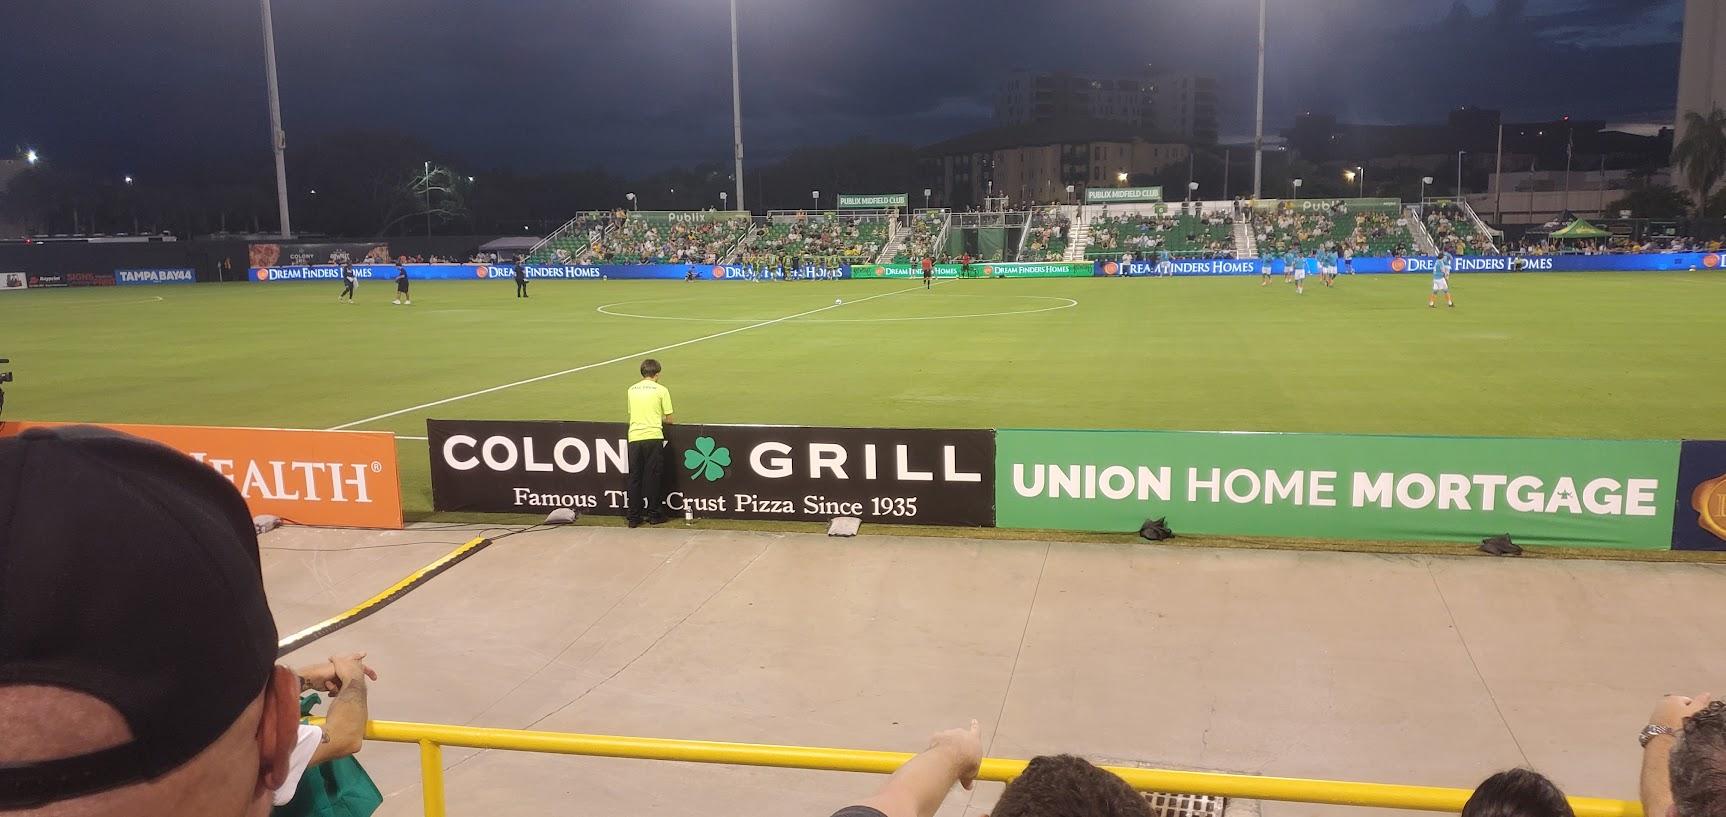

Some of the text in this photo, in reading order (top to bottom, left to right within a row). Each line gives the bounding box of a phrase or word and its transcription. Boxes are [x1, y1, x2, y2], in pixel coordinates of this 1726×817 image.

[1089, 189, 1159, 199] PUBLIX MIDFIELD CLUB
[840, 197, 861, 205] PUBLIX
[862, 196, 888, 204] MIDFIELD
[1303, 200, 1347, 211] Pub
[668, 212, 705, 222] Publix
[994, 266, 1018, 274] DREAM
[1046, 265, 1069, 273] HOMES
[1212, 261, 1254, 273] HOMES
[1455, 257, 1504, 271] FINDERS
[120, 271, 159, 281] TAMPA
[159, 270, 192, 281] BAY44
[269, 268, 297, 280] DREAM
[302, 267, 339, 279] FINDERS
[489, 266, 600, 278] DREA FINDERS HOMES
[886, 267, 908, 275] DREAM
[936, 267, 957, 275] HOMES
[443, 434, 982, 482] COLON GRILL
[1013, 462, 1658, 517] UNION HOME MORTGAGE
[513, 487, 597, 508] Famous
[734, 494, 795, 513] Pizza
[803, 495, 863, 516] Since
[871, 496, 918, 517] 1935
